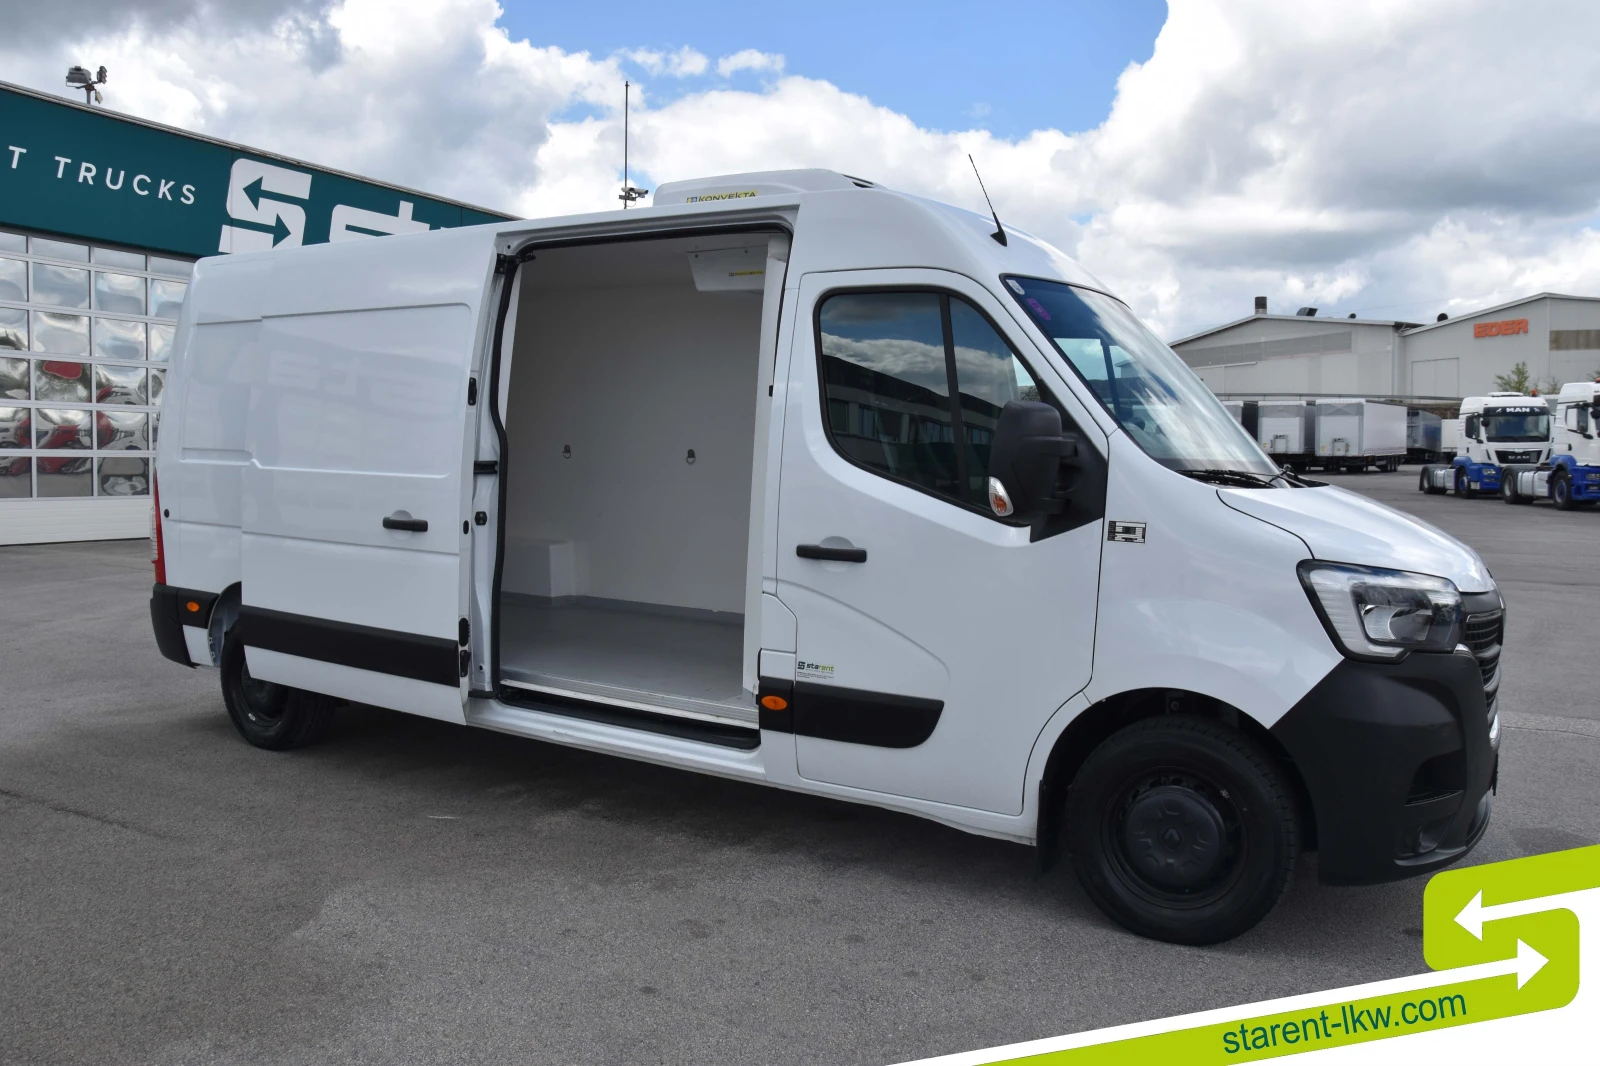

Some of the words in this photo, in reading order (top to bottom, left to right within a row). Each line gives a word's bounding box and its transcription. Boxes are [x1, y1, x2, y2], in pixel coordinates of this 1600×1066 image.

[54, 155, 197, 205] TRUCKS
[698, 191, 757, 203] KONVEKTA
[1474, 318, 1529, 339] EDER
[806, 663, 835, 672] starent
